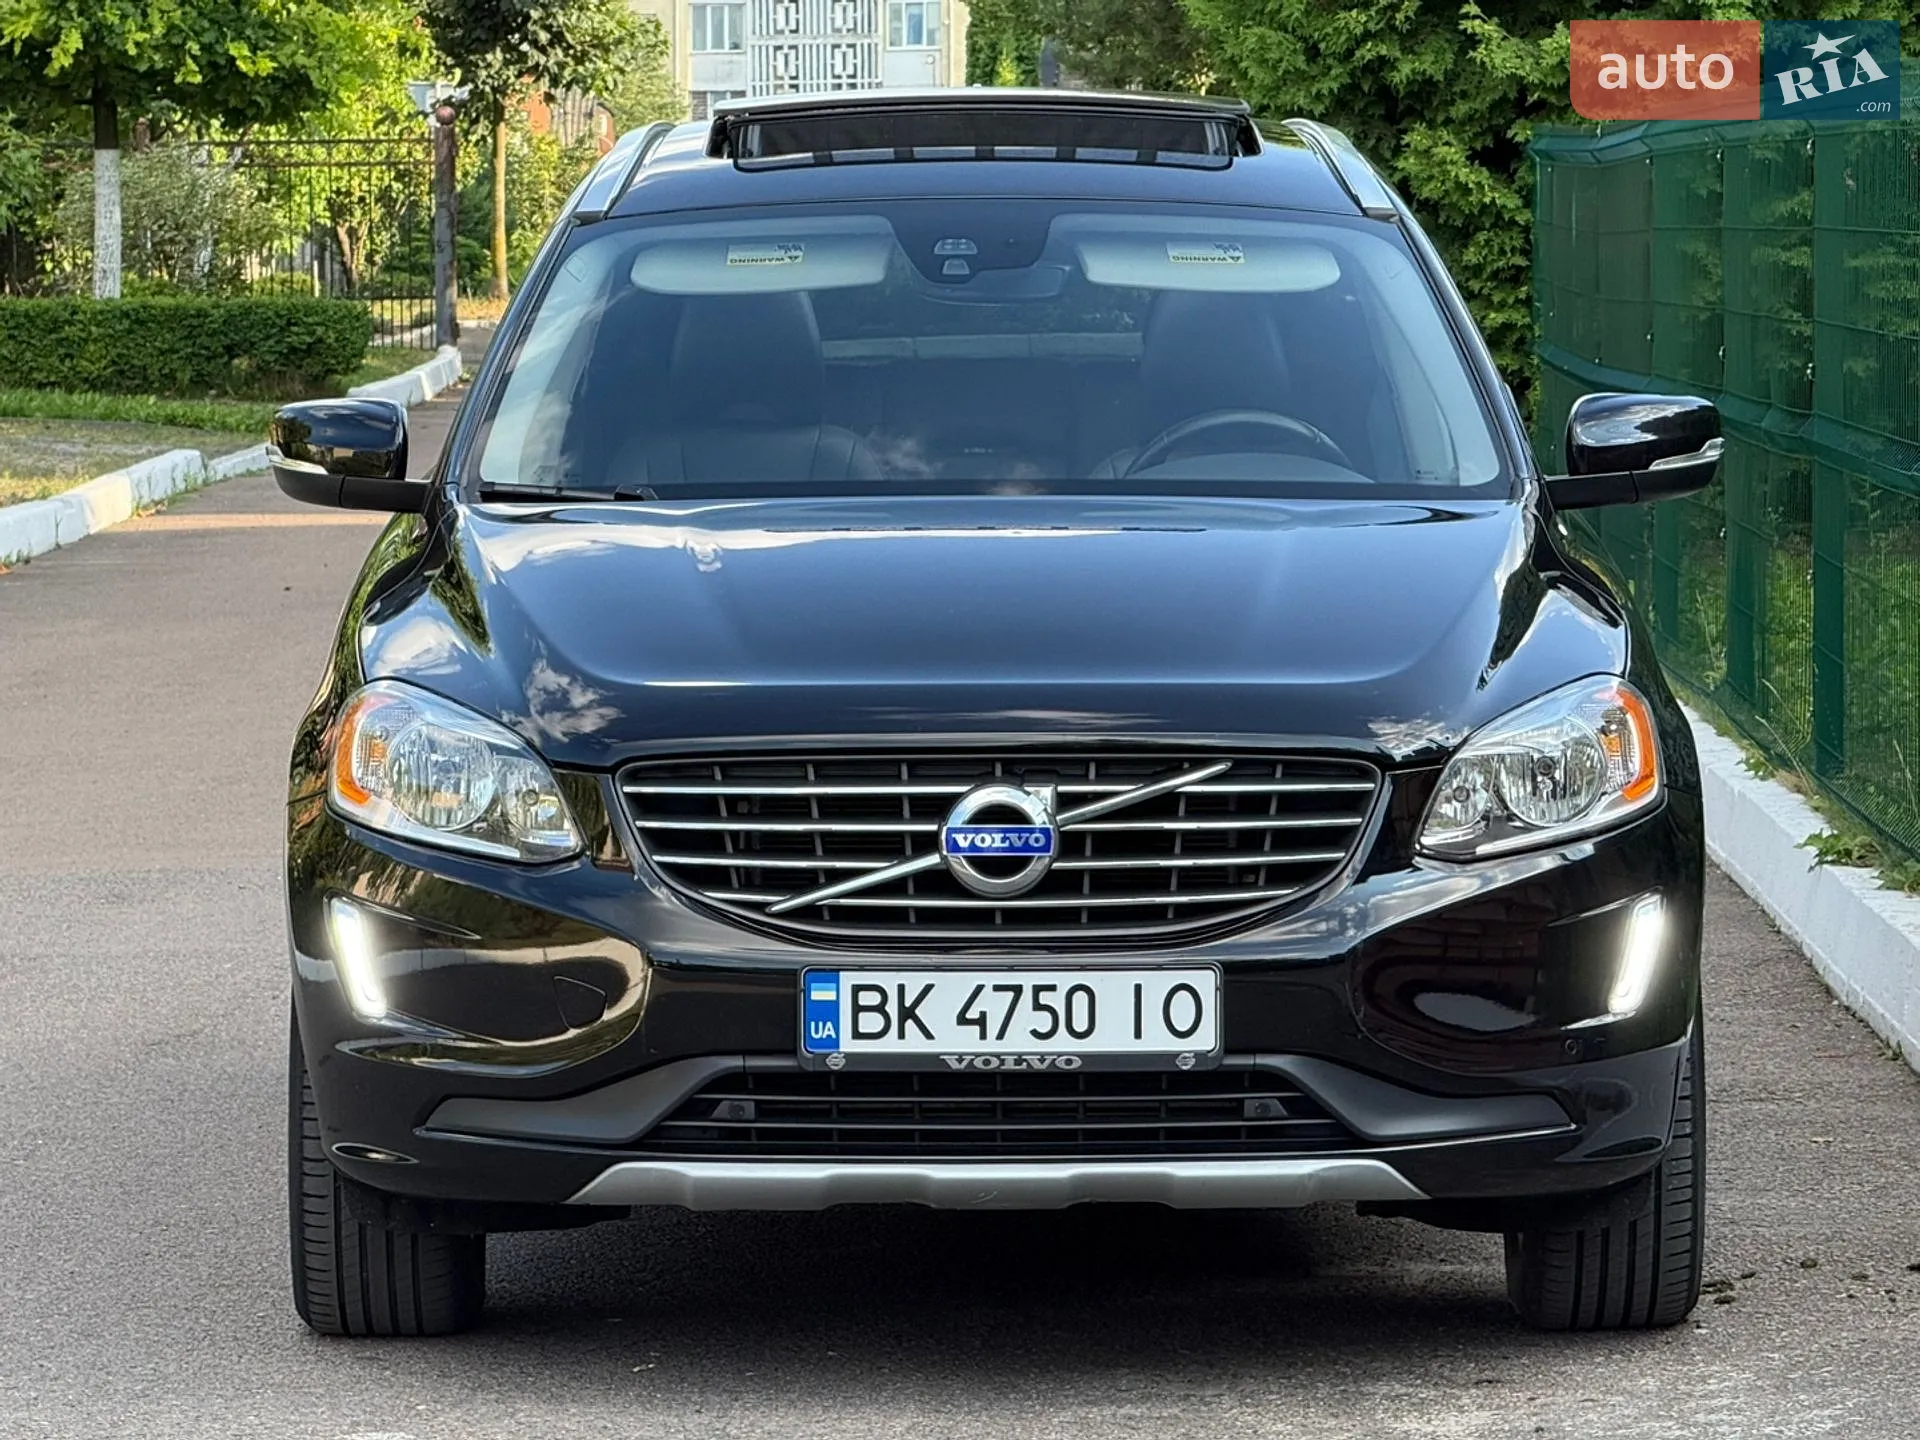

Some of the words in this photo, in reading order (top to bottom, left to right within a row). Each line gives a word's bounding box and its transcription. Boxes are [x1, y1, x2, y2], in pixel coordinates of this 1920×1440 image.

[952, 833, 1046, 848] VOLVO
[850, 983, 936, 1040] BK
[956, 983, 1096, 1040] 4750
[810, 1021, 836, 1039] UA
[939, 1055, 1083, 1070] VOLVO
